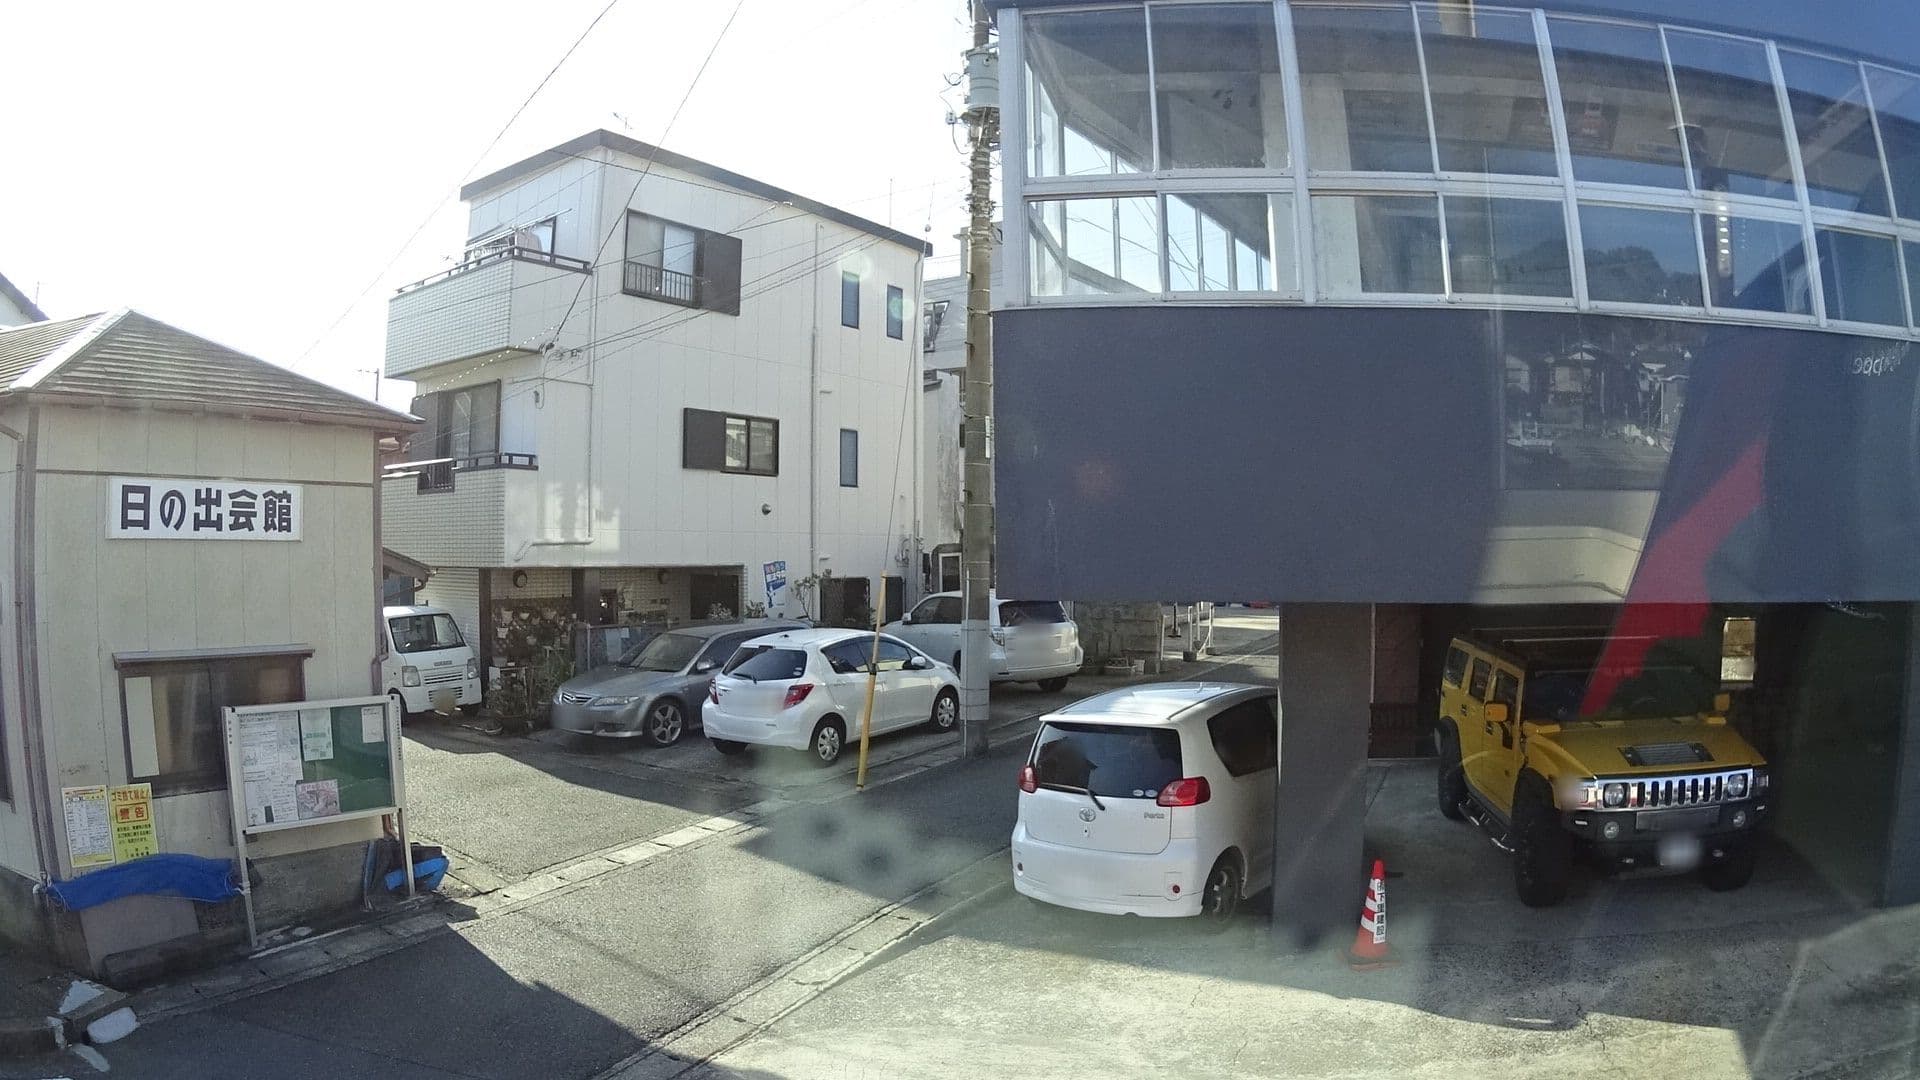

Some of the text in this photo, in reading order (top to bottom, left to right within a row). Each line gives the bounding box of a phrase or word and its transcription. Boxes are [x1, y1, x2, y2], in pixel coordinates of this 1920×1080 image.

[121, 484, 292, 533] 日の出会館
